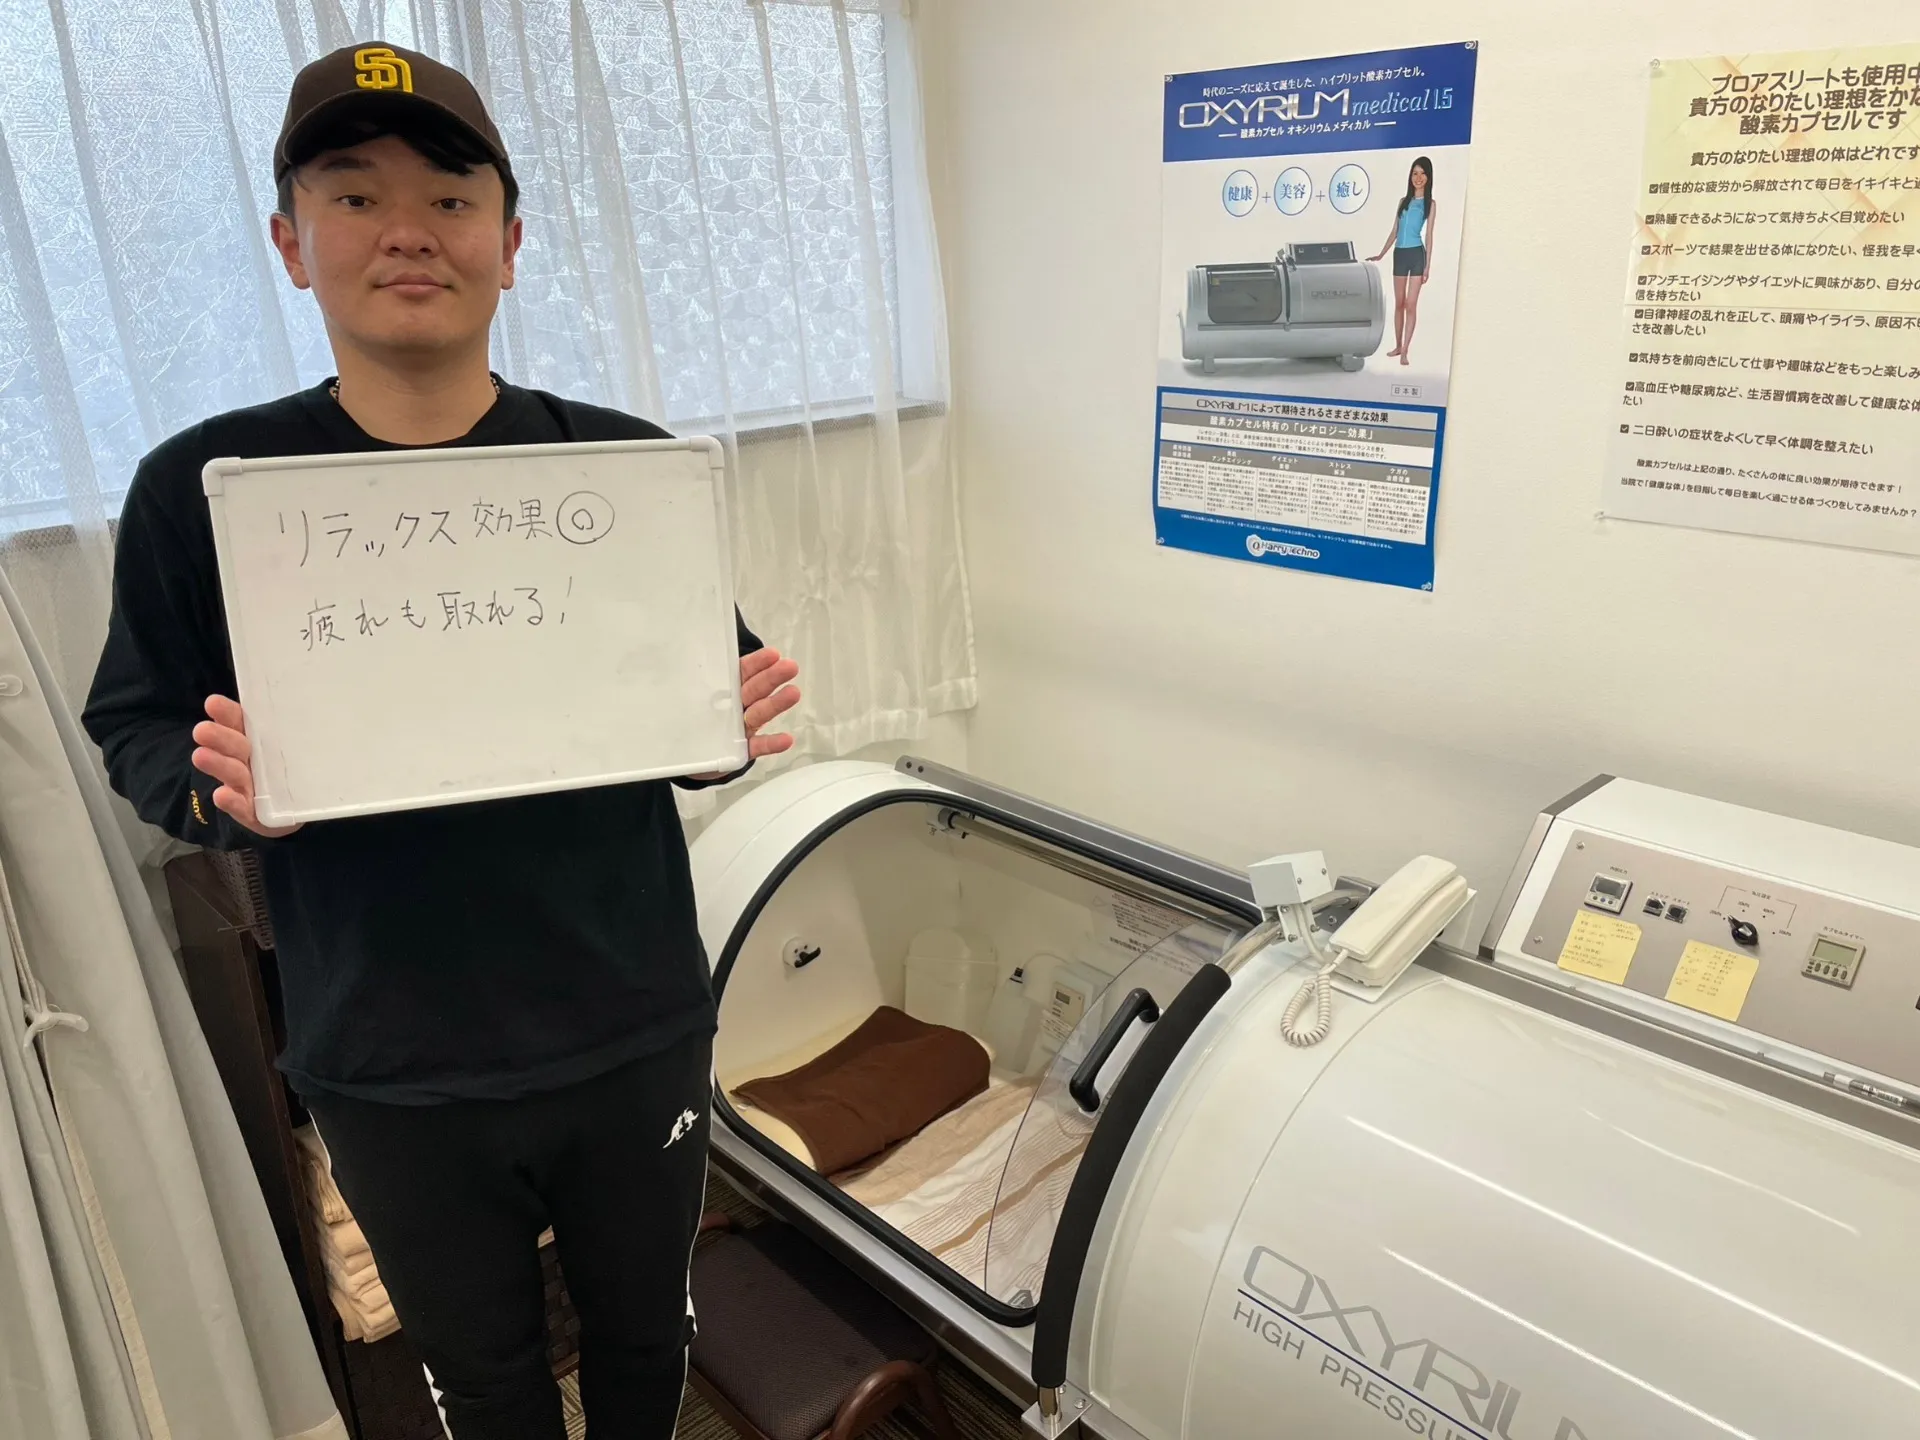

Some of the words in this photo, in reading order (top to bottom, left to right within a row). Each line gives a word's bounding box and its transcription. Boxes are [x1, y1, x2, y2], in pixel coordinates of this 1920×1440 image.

[1178, 88, 1350, 129] OXYRIUM
[1352, 88, 1431, 116] medical
[1240, 125, 1285, 139] 酸素カプセル
[1287, 123, 1331, 135] オキシリウム
[1332, 119, 1372, 133] メディカル
[1739, 108, 1907, 135] 酸素カプセルです
[1227, 185, 1254, 202] 健康
[1279, 182, 1306, 200] 美容
[1335, 179, 1364, 198] 癒し
[1654, 210, 1905, 225] 熟睡できるようになって気持ちよく目覚めたい
[1635, 289, 1701, 302] 信を持ちたい
[1643, 308, 1920, 330] 自律神経の乱れを正して、頭痛やイライラ、原因不
[1631, 323, 1706, 337] さを改善したい
[1622, 394, 1643, 407] たい
[1632, 424, 1874, 455] 二日酔いの症状をよくして早く体調を整えたい
[1232, 1300, 1306, 1360] HIGH
[1319, 1353, 1470, 1440] PRESSU
